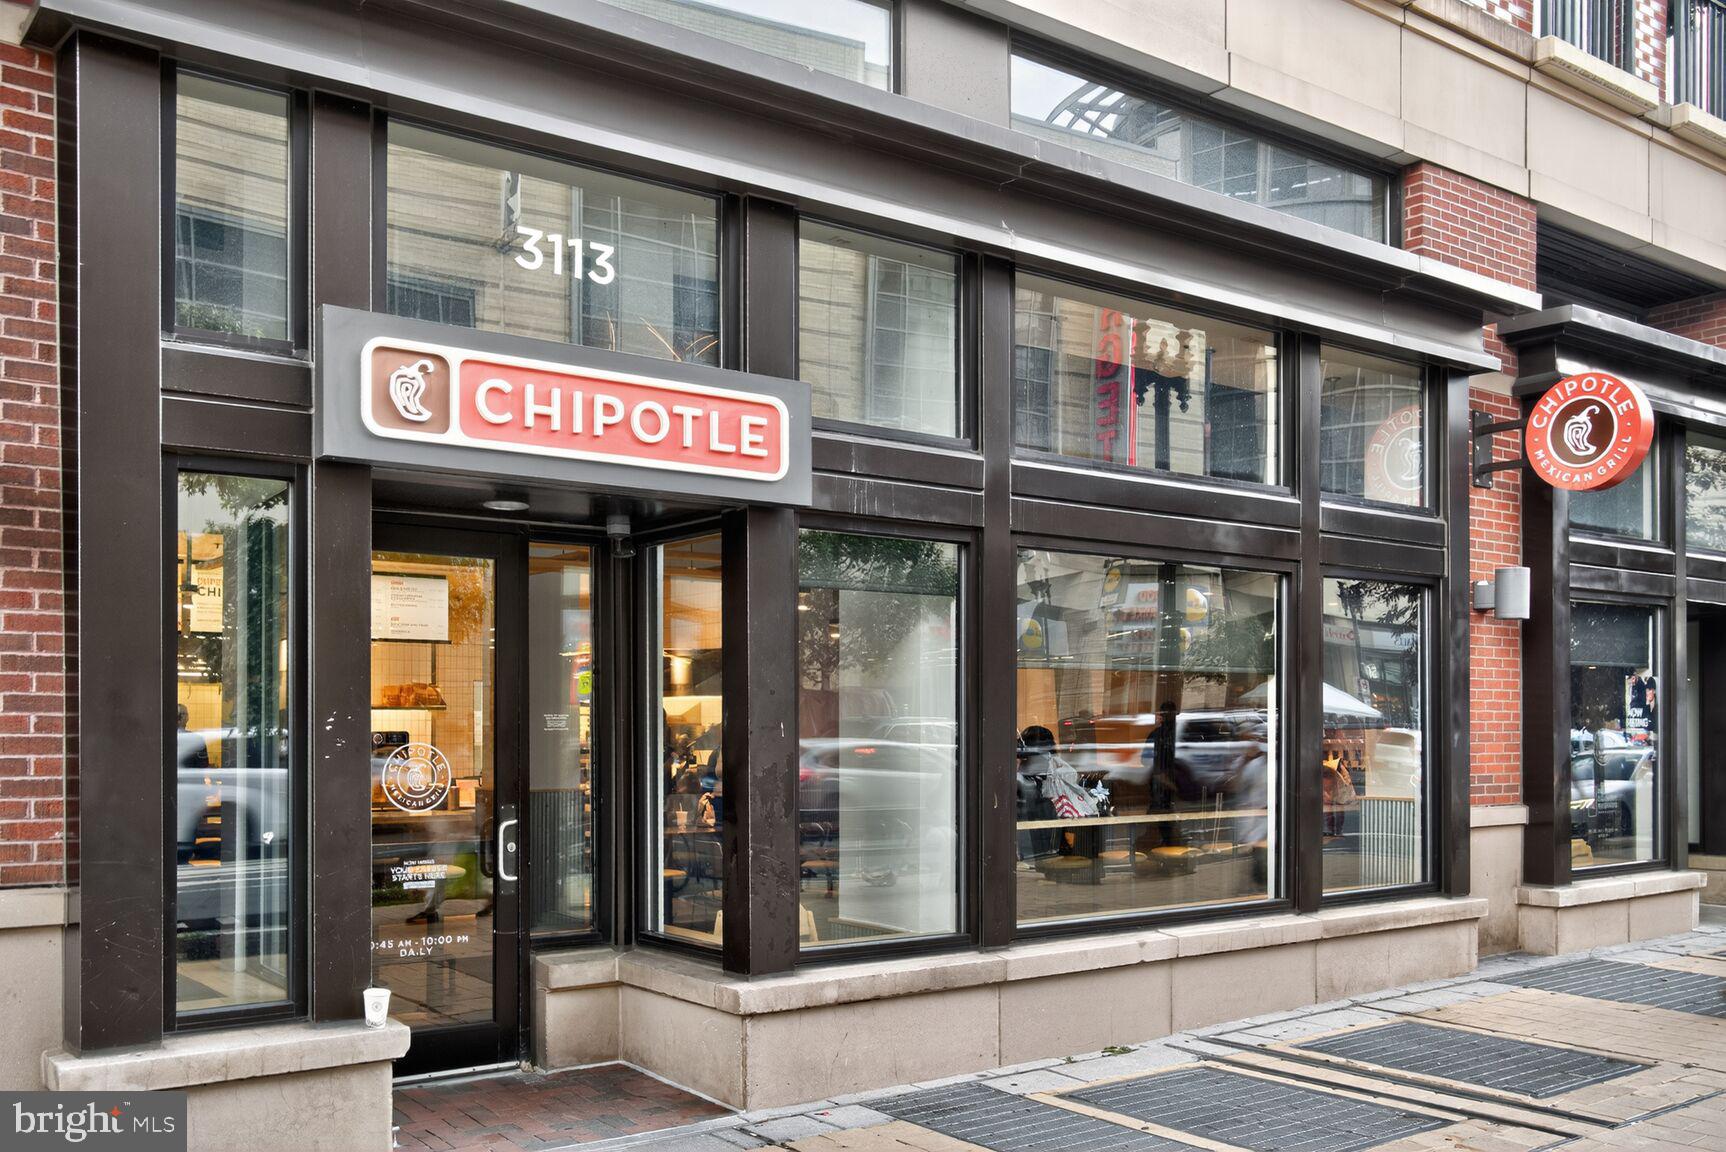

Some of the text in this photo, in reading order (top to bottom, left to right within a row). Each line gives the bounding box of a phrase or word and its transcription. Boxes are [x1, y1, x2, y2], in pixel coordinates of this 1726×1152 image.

[514, 225, 615, 285] 3113
[474, 378, 769, 457] CHIPOTLE
[1532, 376, 1634, 429] CHIPOTLE
[1534, 435, 1632, 483] MEXICAN GRILL
[388, 746, 446, 773] CHIPOTLE
[390, 783, 424, 807] MEXICAN
[398, 939, 412, 948] AM
[421, 935, 453, 946] 10:00
[456, 935, 469, 943] PM
